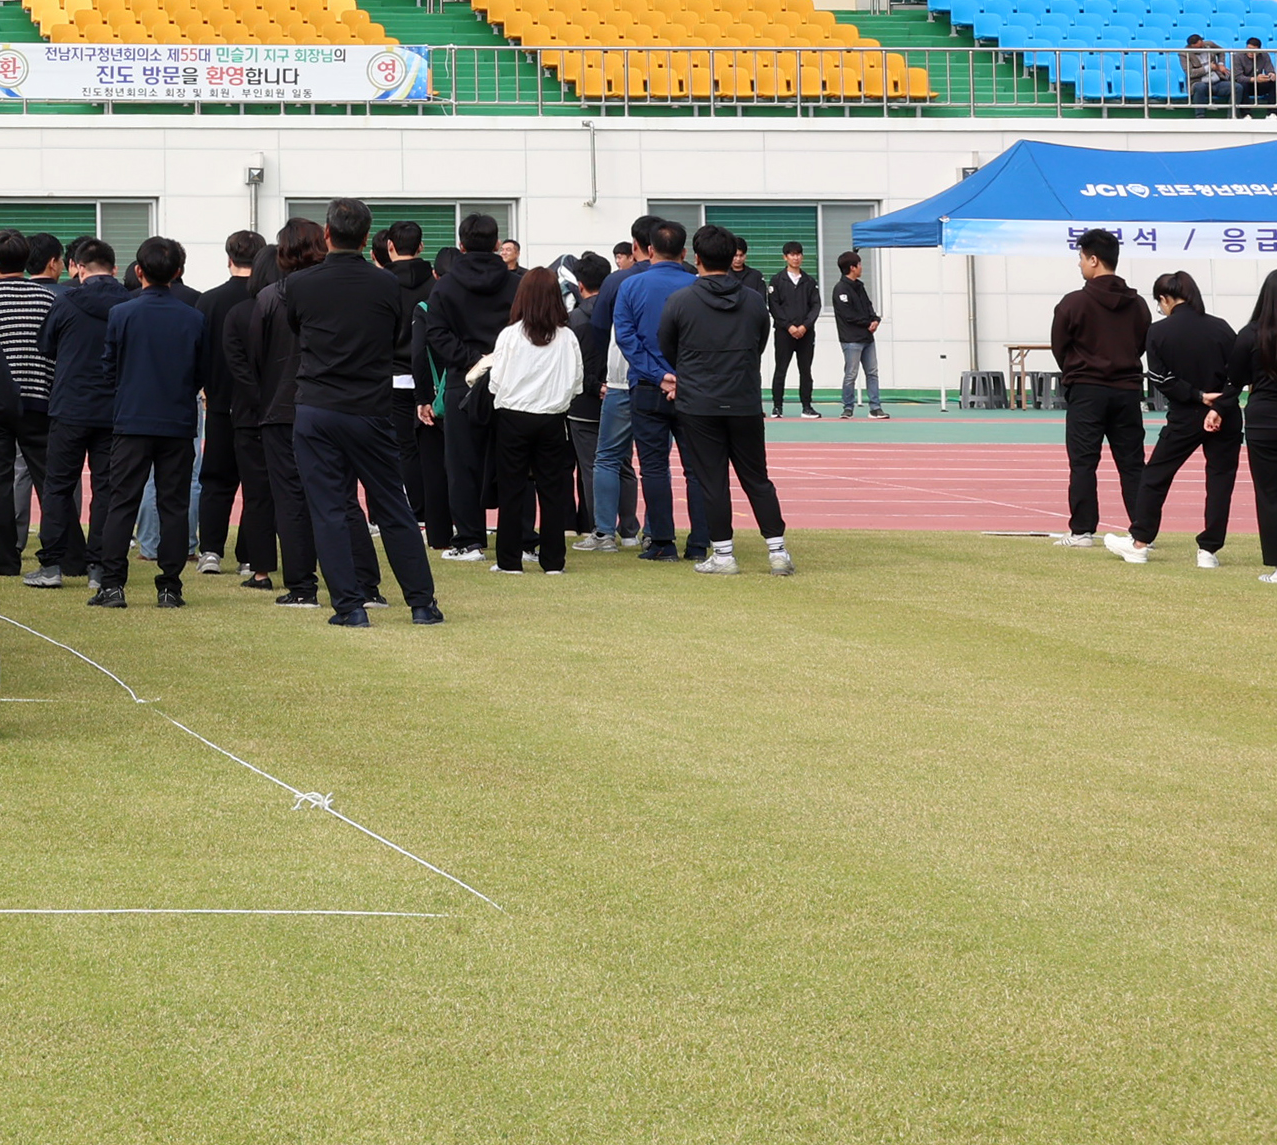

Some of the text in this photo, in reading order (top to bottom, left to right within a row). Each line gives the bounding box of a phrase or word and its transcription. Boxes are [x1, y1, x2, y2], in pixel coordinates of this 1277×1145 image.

[45, 46, 346, 63] 전남지구청년회의소 제55대 민슬기 지구 회장님의
[96, 65, 300, 86] 진도 방문을 환영합니다
[377, 59, 396, 82] 영
[82, 87, 158, 97] 진도청년회의소
[165, 88, 186, 98] 회장
[193, 88, 202, 98] 및
[242, 88, 285, 99] 부인회원
[292, 89, 313, 99] 일동
[1080, 183, 1128, 197] JCI
[1183, 228, 1196, 251] /
